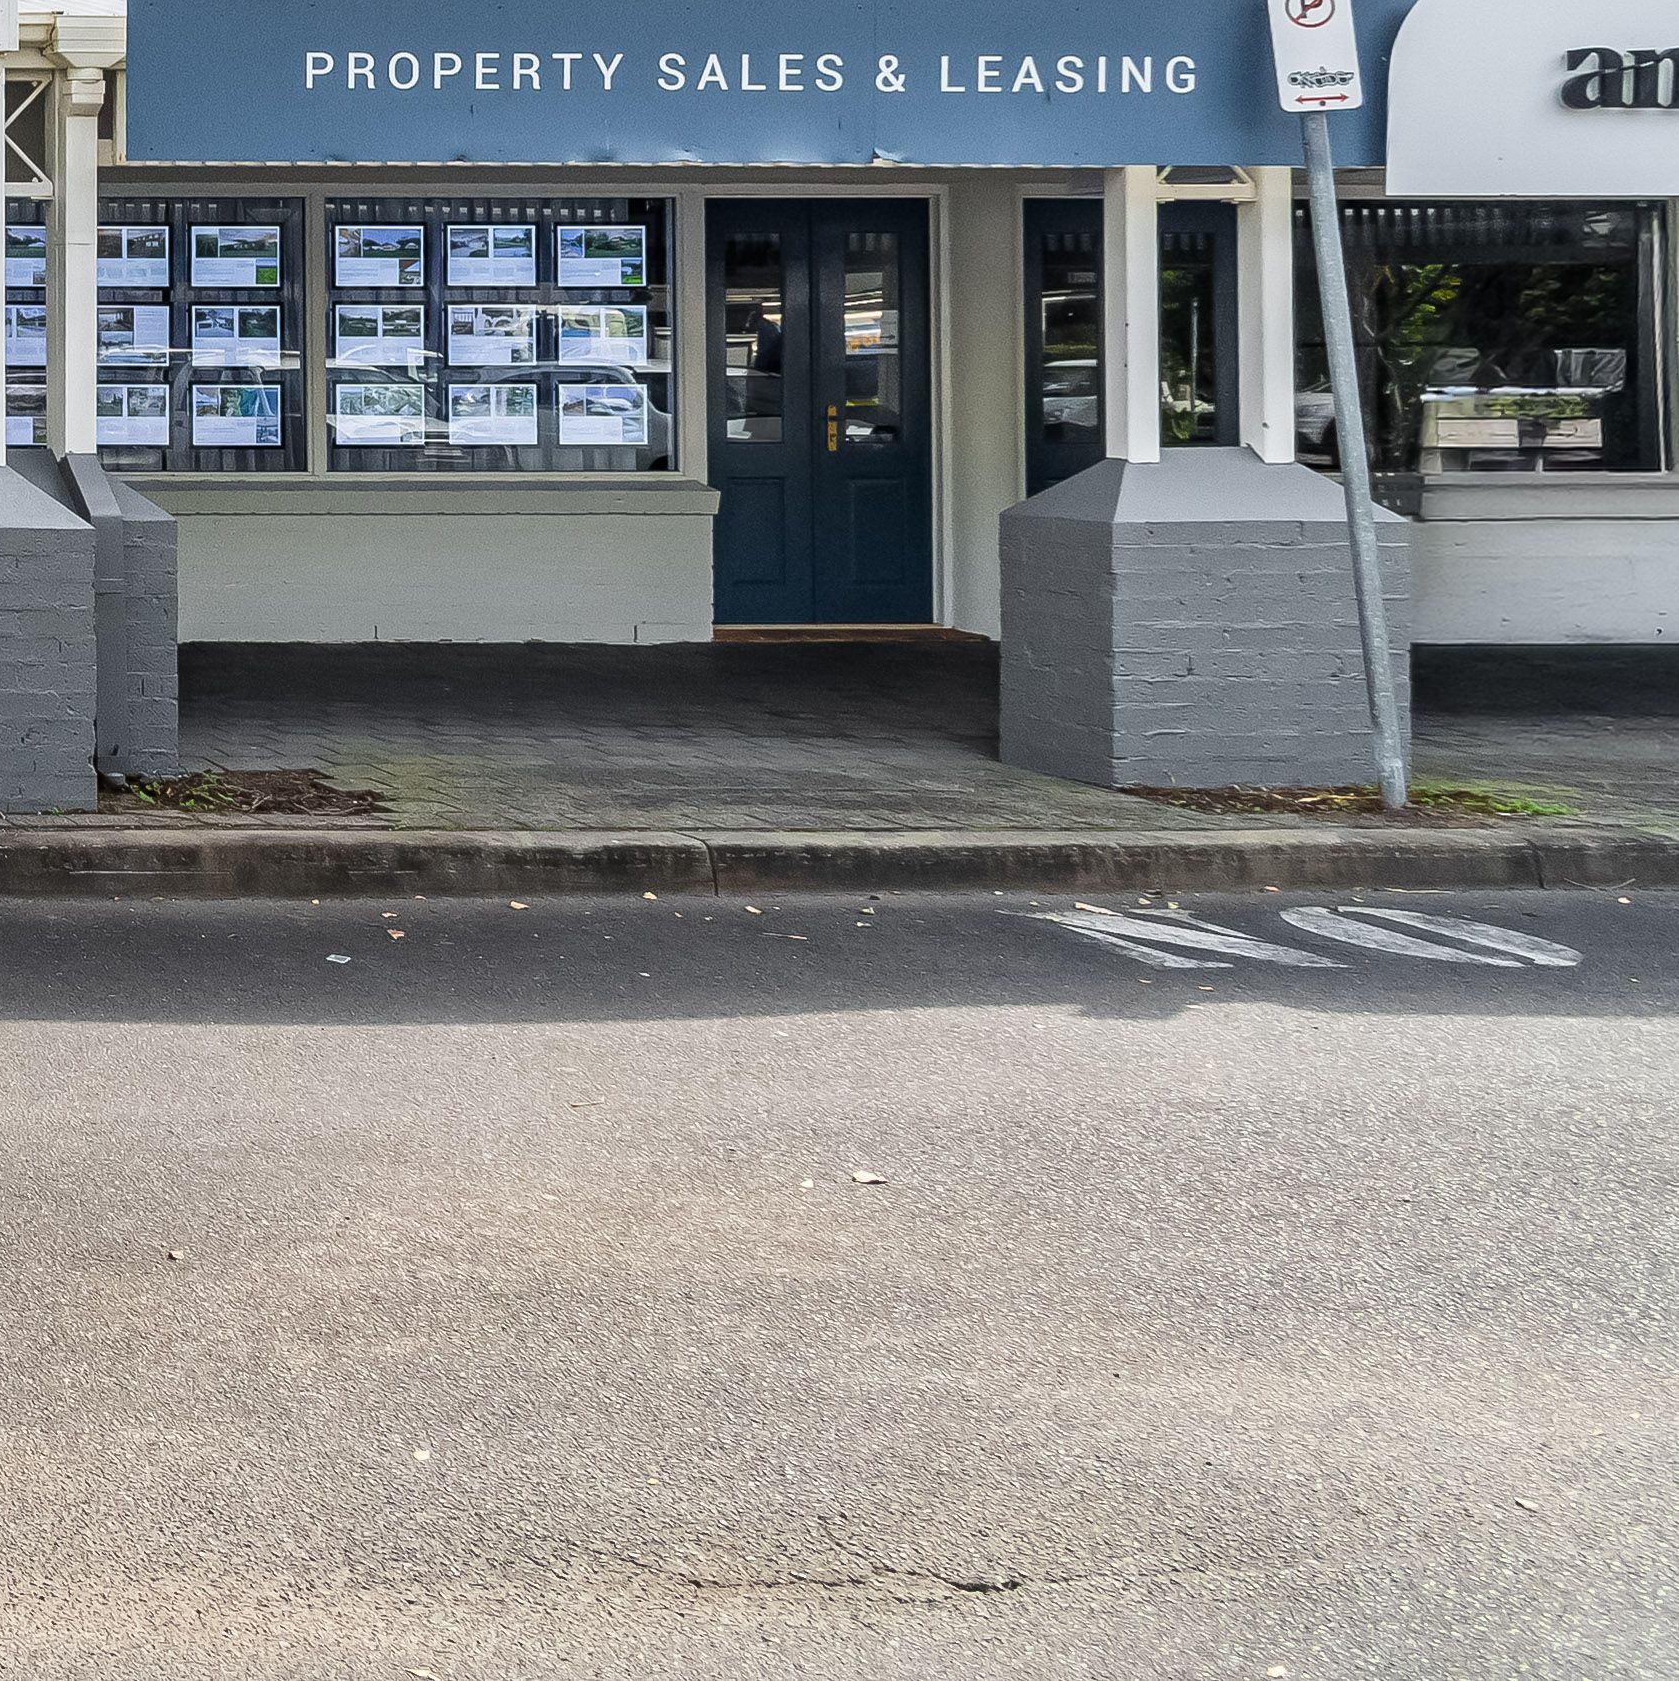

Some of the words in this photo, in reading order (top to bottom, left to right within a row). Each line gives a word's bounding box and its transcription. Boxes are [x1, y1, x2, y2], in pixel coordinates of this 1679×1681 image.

[304, 51, 624, 91] PROPERTY
[656, 52, 845, 92] SALES
[874, 53, 906, 93] &
[939, 54, 1197, 94] LEASING
